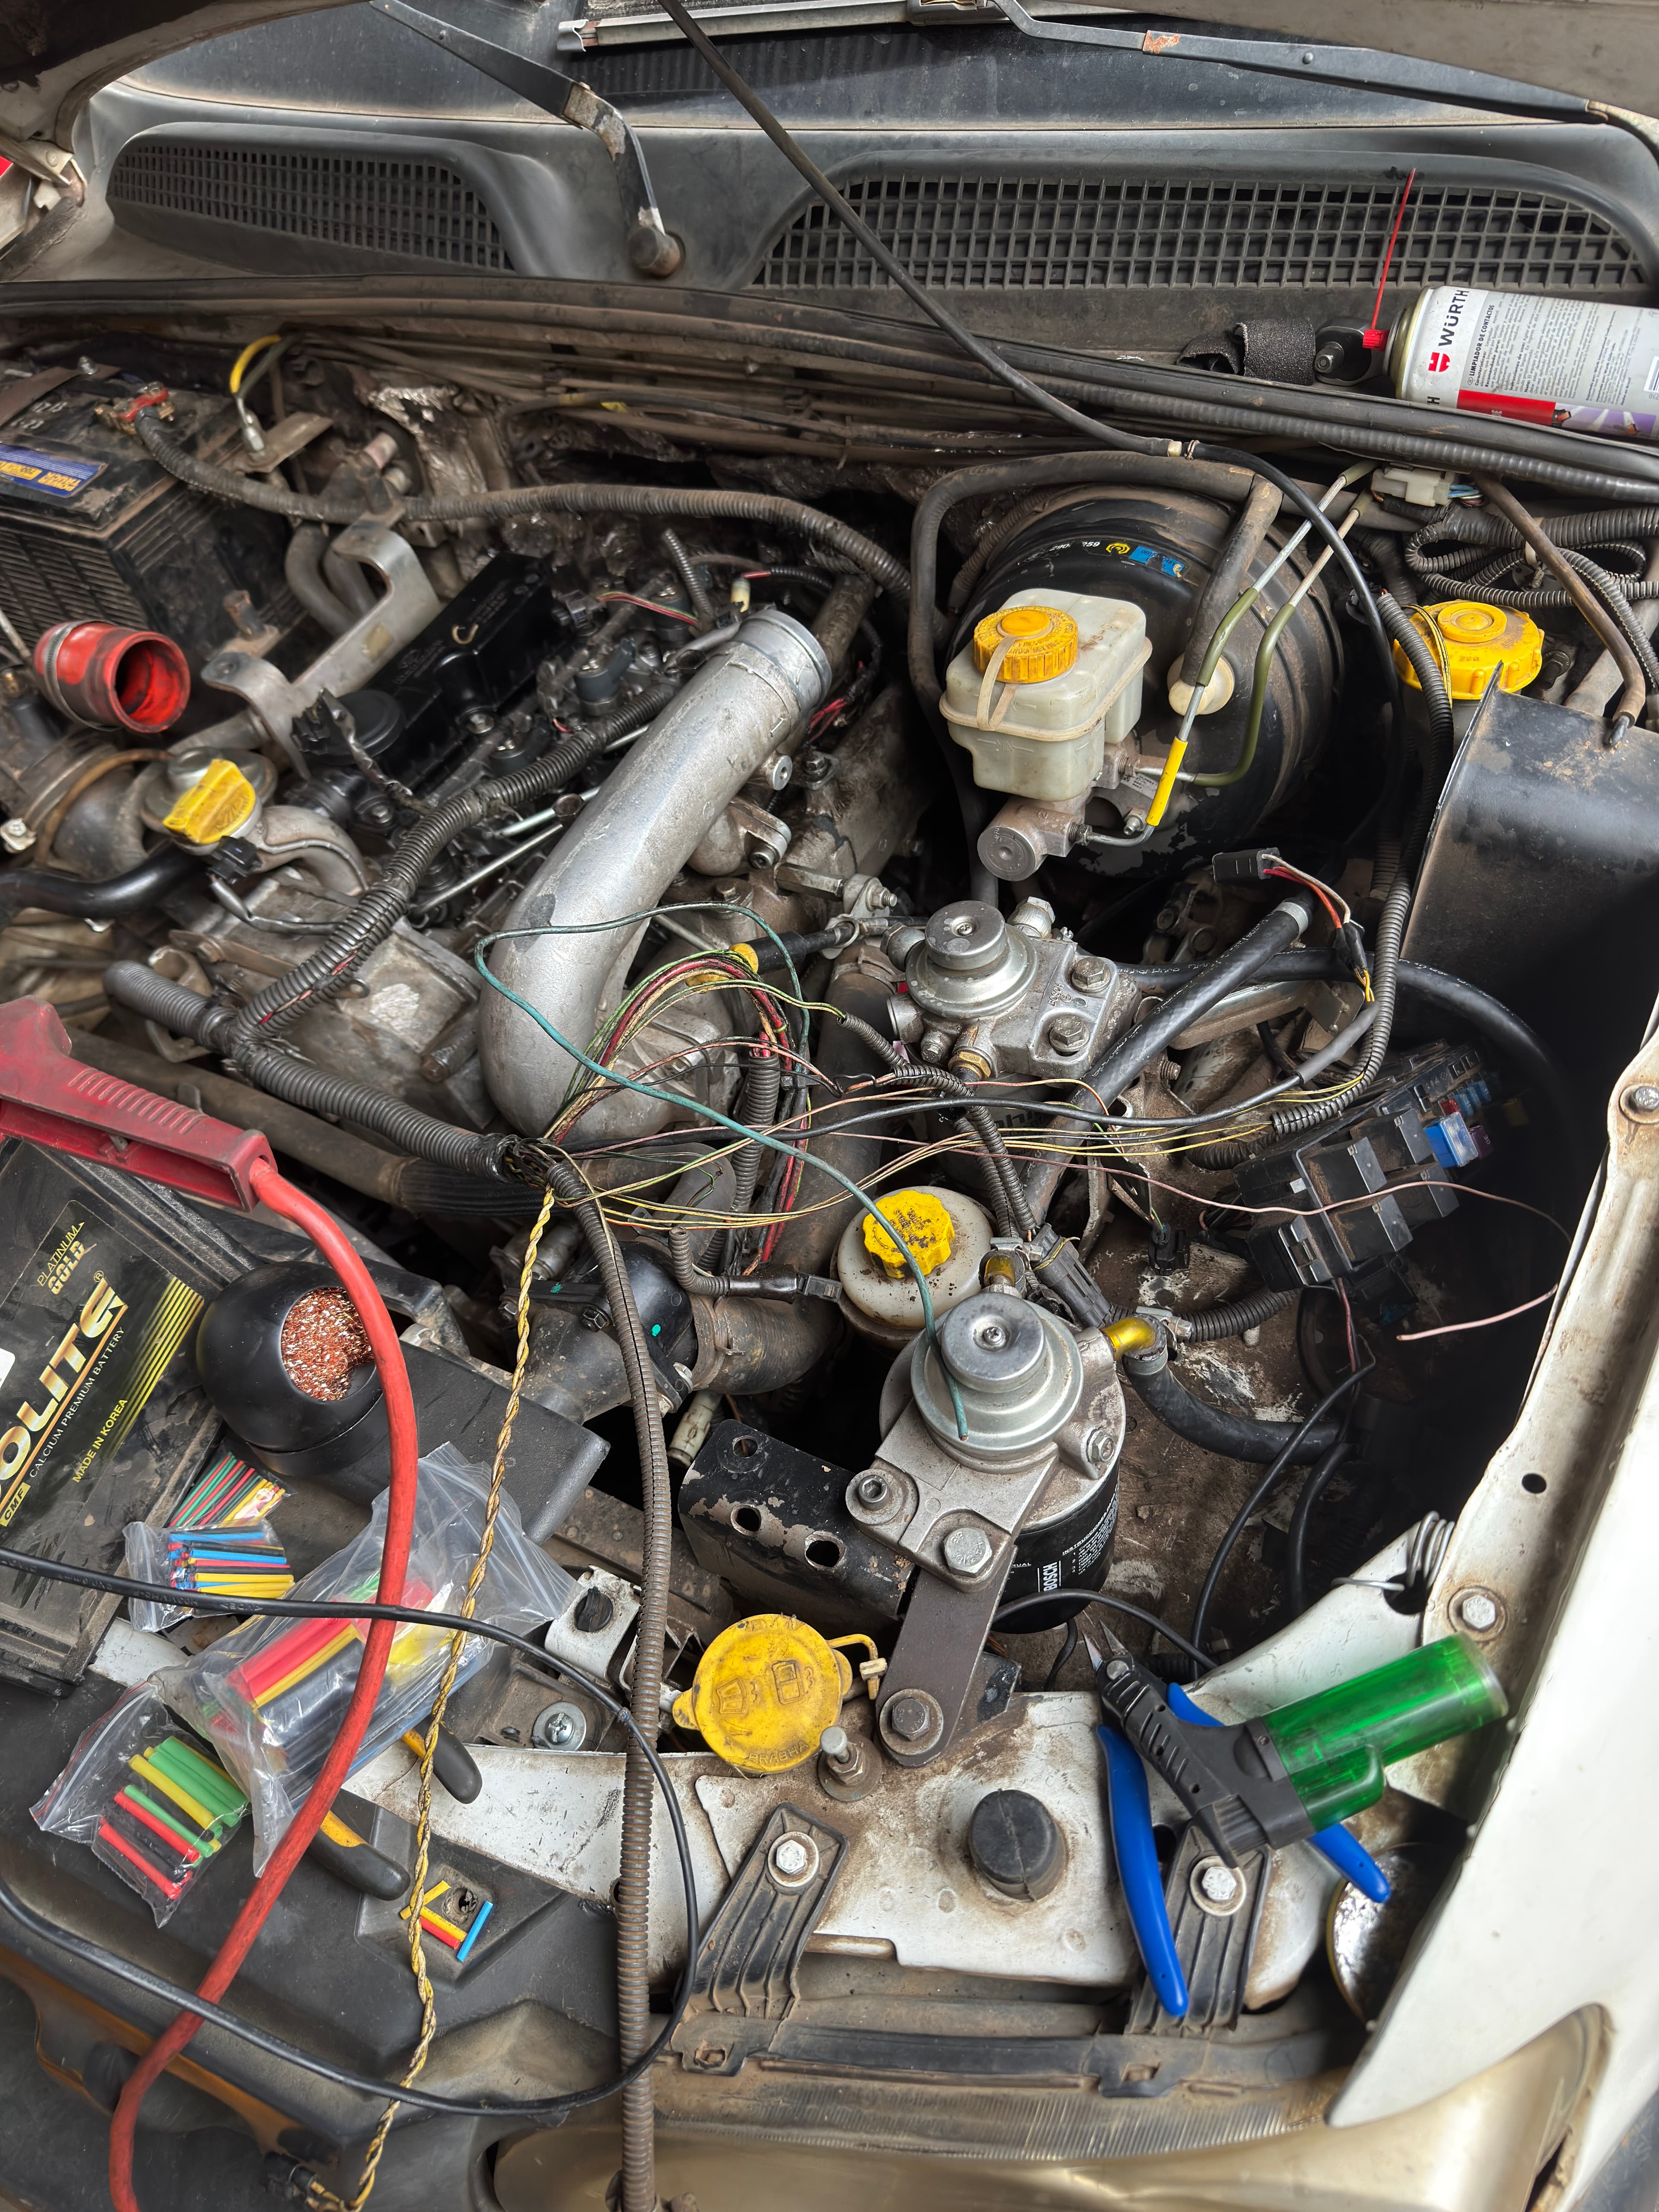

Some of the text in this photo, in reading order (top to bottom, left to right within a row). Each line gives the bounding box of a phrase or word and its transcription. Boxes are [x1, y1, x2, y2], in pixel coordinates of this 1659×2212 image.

[1438, 289, 1469, 346] WÜRTH
[1468, 304, 1494, 376] LIMPIADOR DE CONTACTOS
[1049, 982, 1063, 1007] BOSCH
[1483, 1134, 1491, 1145] 30
[893, 1208, 918, 1243] STEERING
[906, 1208, 925, 1232] POWER
[37, 1227, 79, 1287] PLATINUM
[48, 1241, 85, 1295] GOLD
[0, 1279, 128, 1499] OLITE
[30, 1327, 125, 1478] CALCIUM PREMIUM BATTERY
[73, 1398, 128, 1483] MADE IN KOREA
[3, 1487, 26, 1521] CMF
[1043, 1561, 1058, 1592] BOSCH
[749, 1741, 809, 1764] PRABHA
